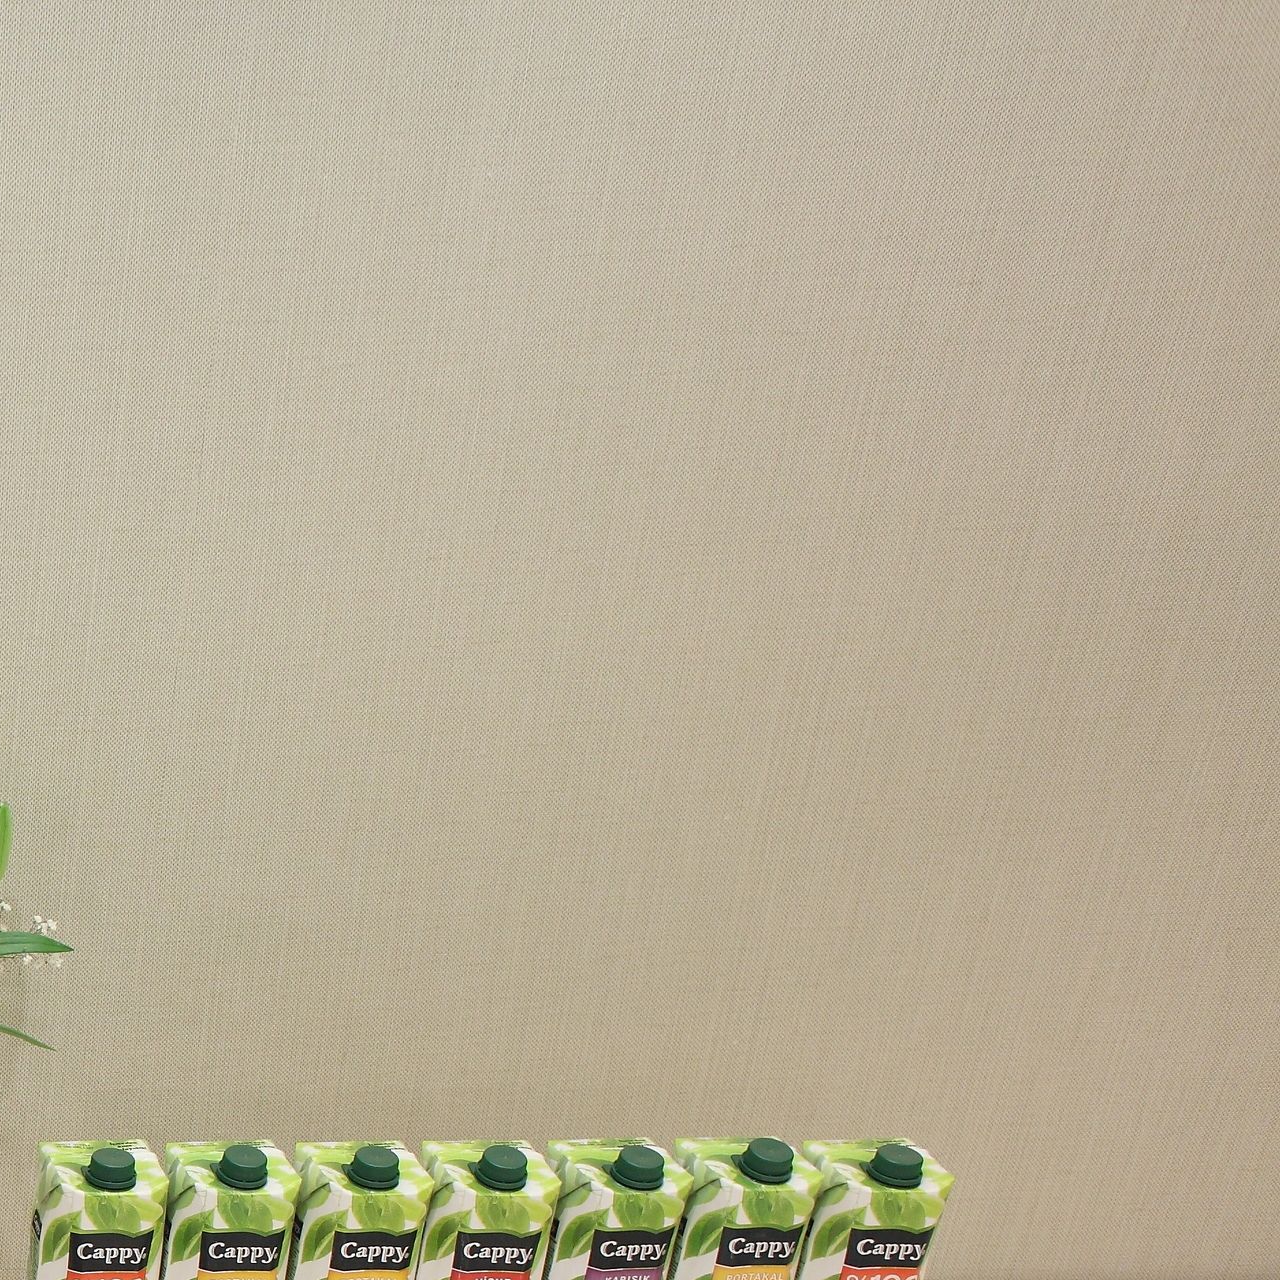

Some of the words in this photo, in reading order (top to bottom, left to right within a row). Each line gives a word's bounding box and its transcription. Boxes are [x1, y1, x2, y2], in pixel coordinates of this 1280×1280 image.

[76, 1242, 145, 1265] Cappy
[208, 1242, 277, 1264] Cappy
[340, 1242, 409, 1263] Cappy
[463, 1242, 533, 1264] Cappy
[600, 1240, 667, 1261] Cappy
[728, 1238, 795, 1259] Cappy
[856, 1239, 927, 1261] Cappy
